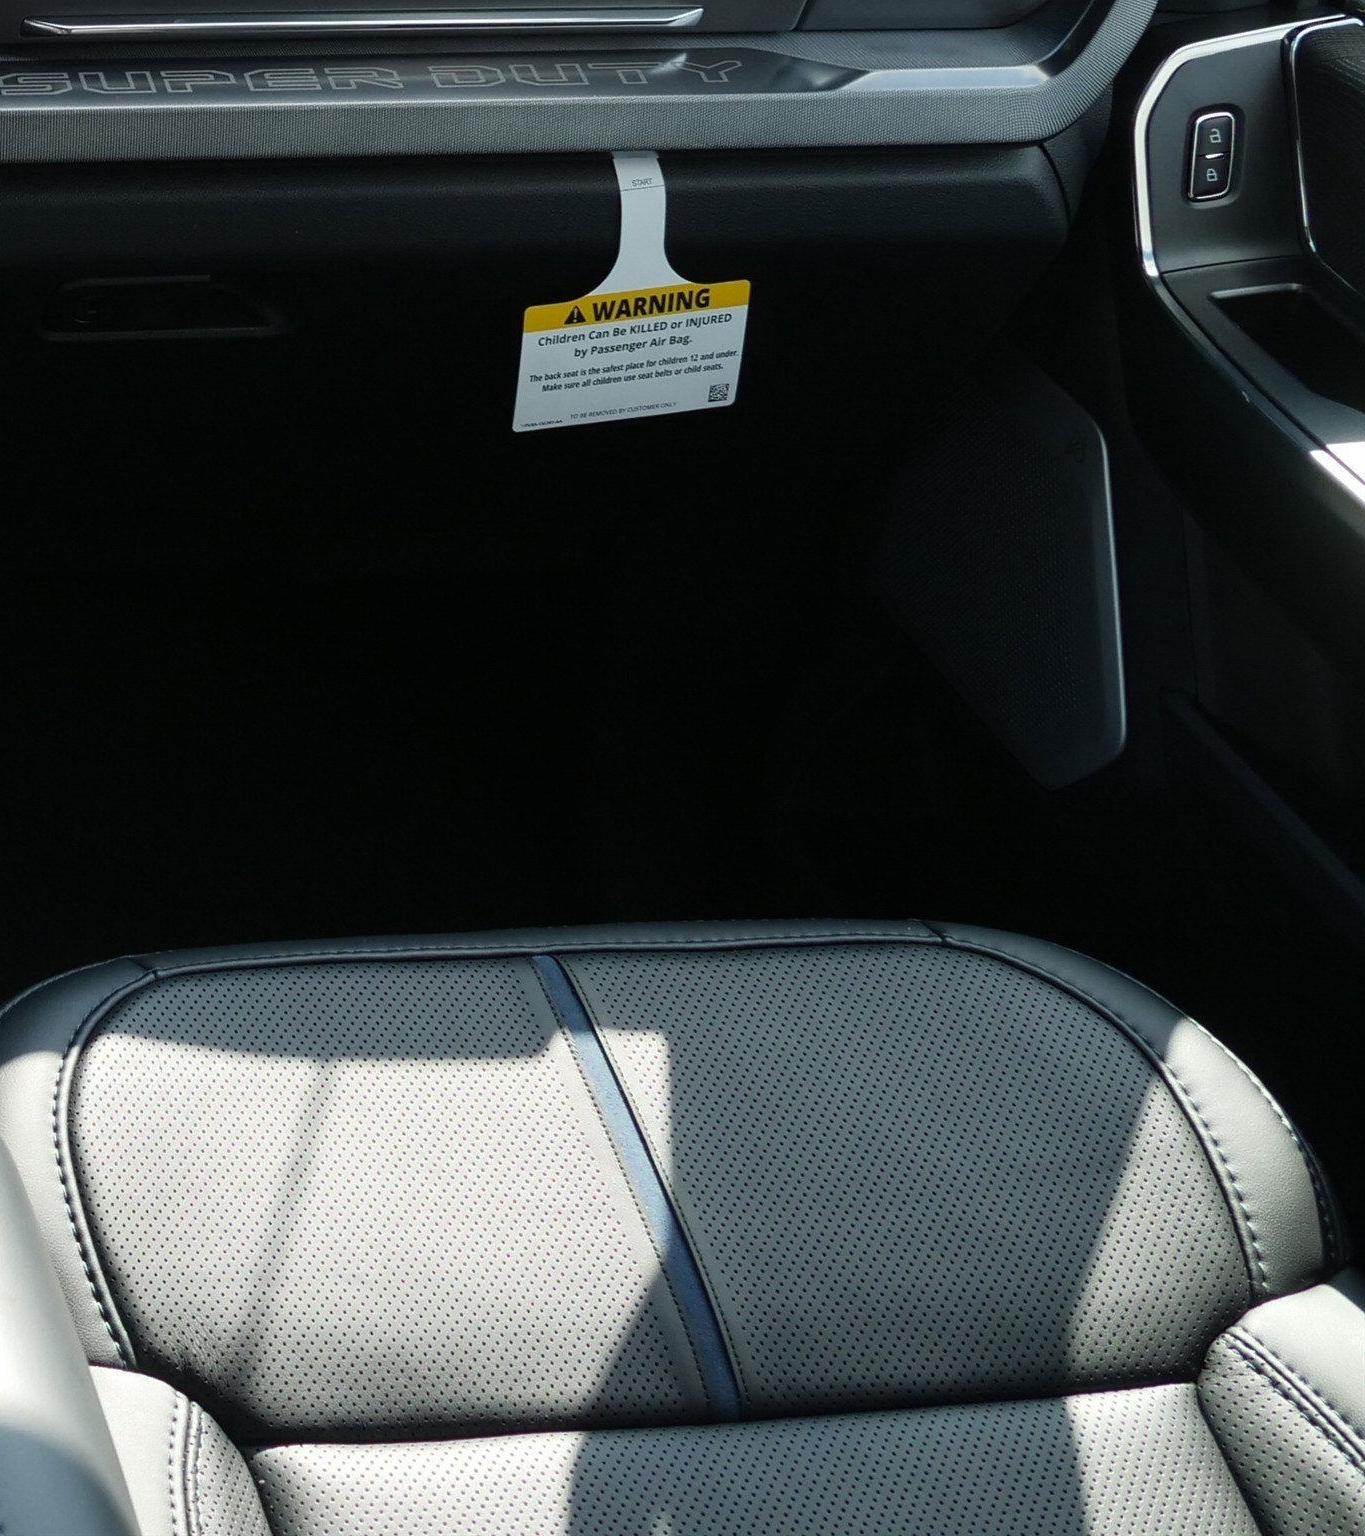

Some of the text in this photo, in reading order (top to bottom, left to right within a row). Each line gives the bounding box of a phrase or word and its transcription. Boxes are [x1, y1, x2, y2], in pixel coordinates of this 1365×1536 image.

[427, 61, 743, 94] DUTY
[592, 287, 711, 322] WARNING
[538, 313, 732, 347] Children Can Be KILLED or INJURED
[574, 334, 693, 357] by Passenger Air Bag.
[529, 349, 739, 383] The back seat is the safest place for children 12 and under.
[541, 362, 724, 392] Make sure all children use seat belts or child seats.
[588, 408, 618, 418] REMOVED
[627, 403, 660, 413] CUSTOMER
